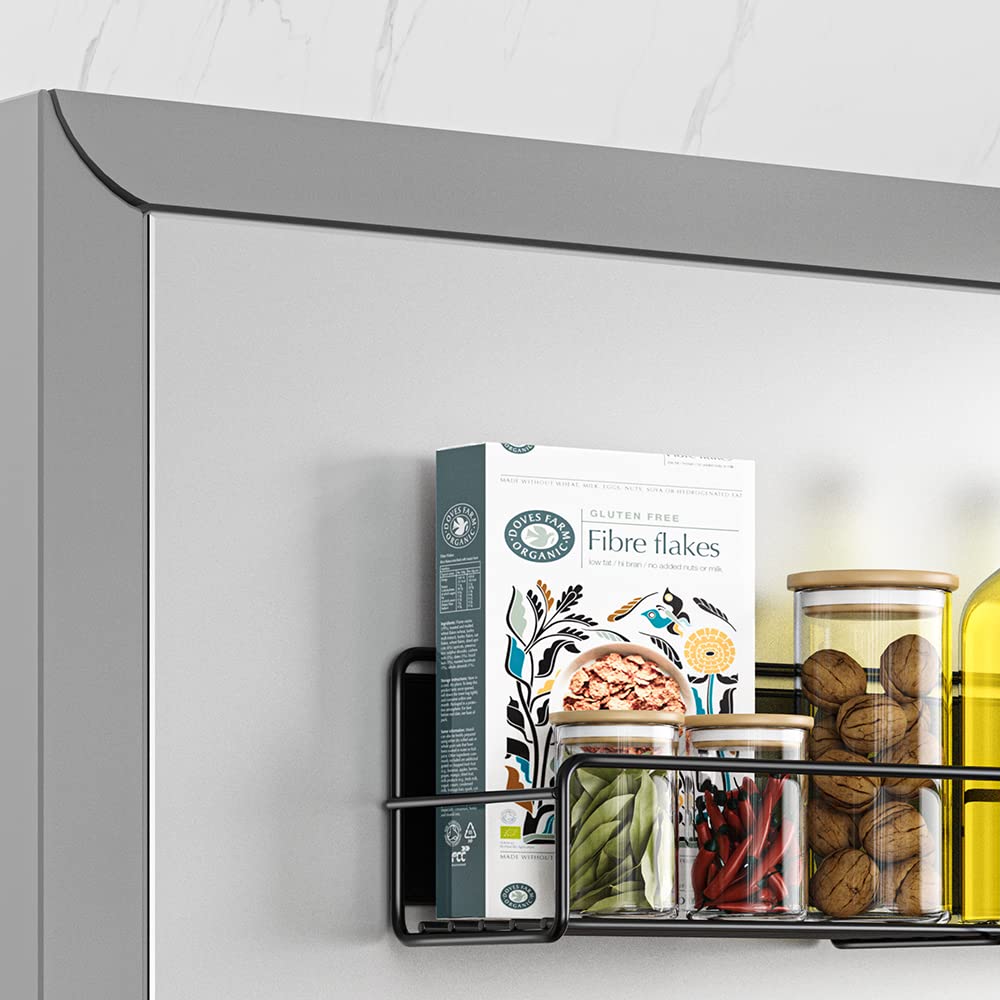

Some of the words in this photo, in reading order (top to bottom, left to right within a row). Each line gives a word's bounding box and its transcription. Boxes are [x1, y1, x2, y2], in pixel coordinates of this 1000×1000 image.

[508, 512, 542, 538] DOVES
[544, 514, 571, 540] FARM
[590, 509, 641, 520] GLUTEN
[647, 512, 680, 523] FREE
[512, 542, 568, 561] ORGANIC
[588, 528, 647, 554] Fibre
[654, 531, 720, 558] flakes
